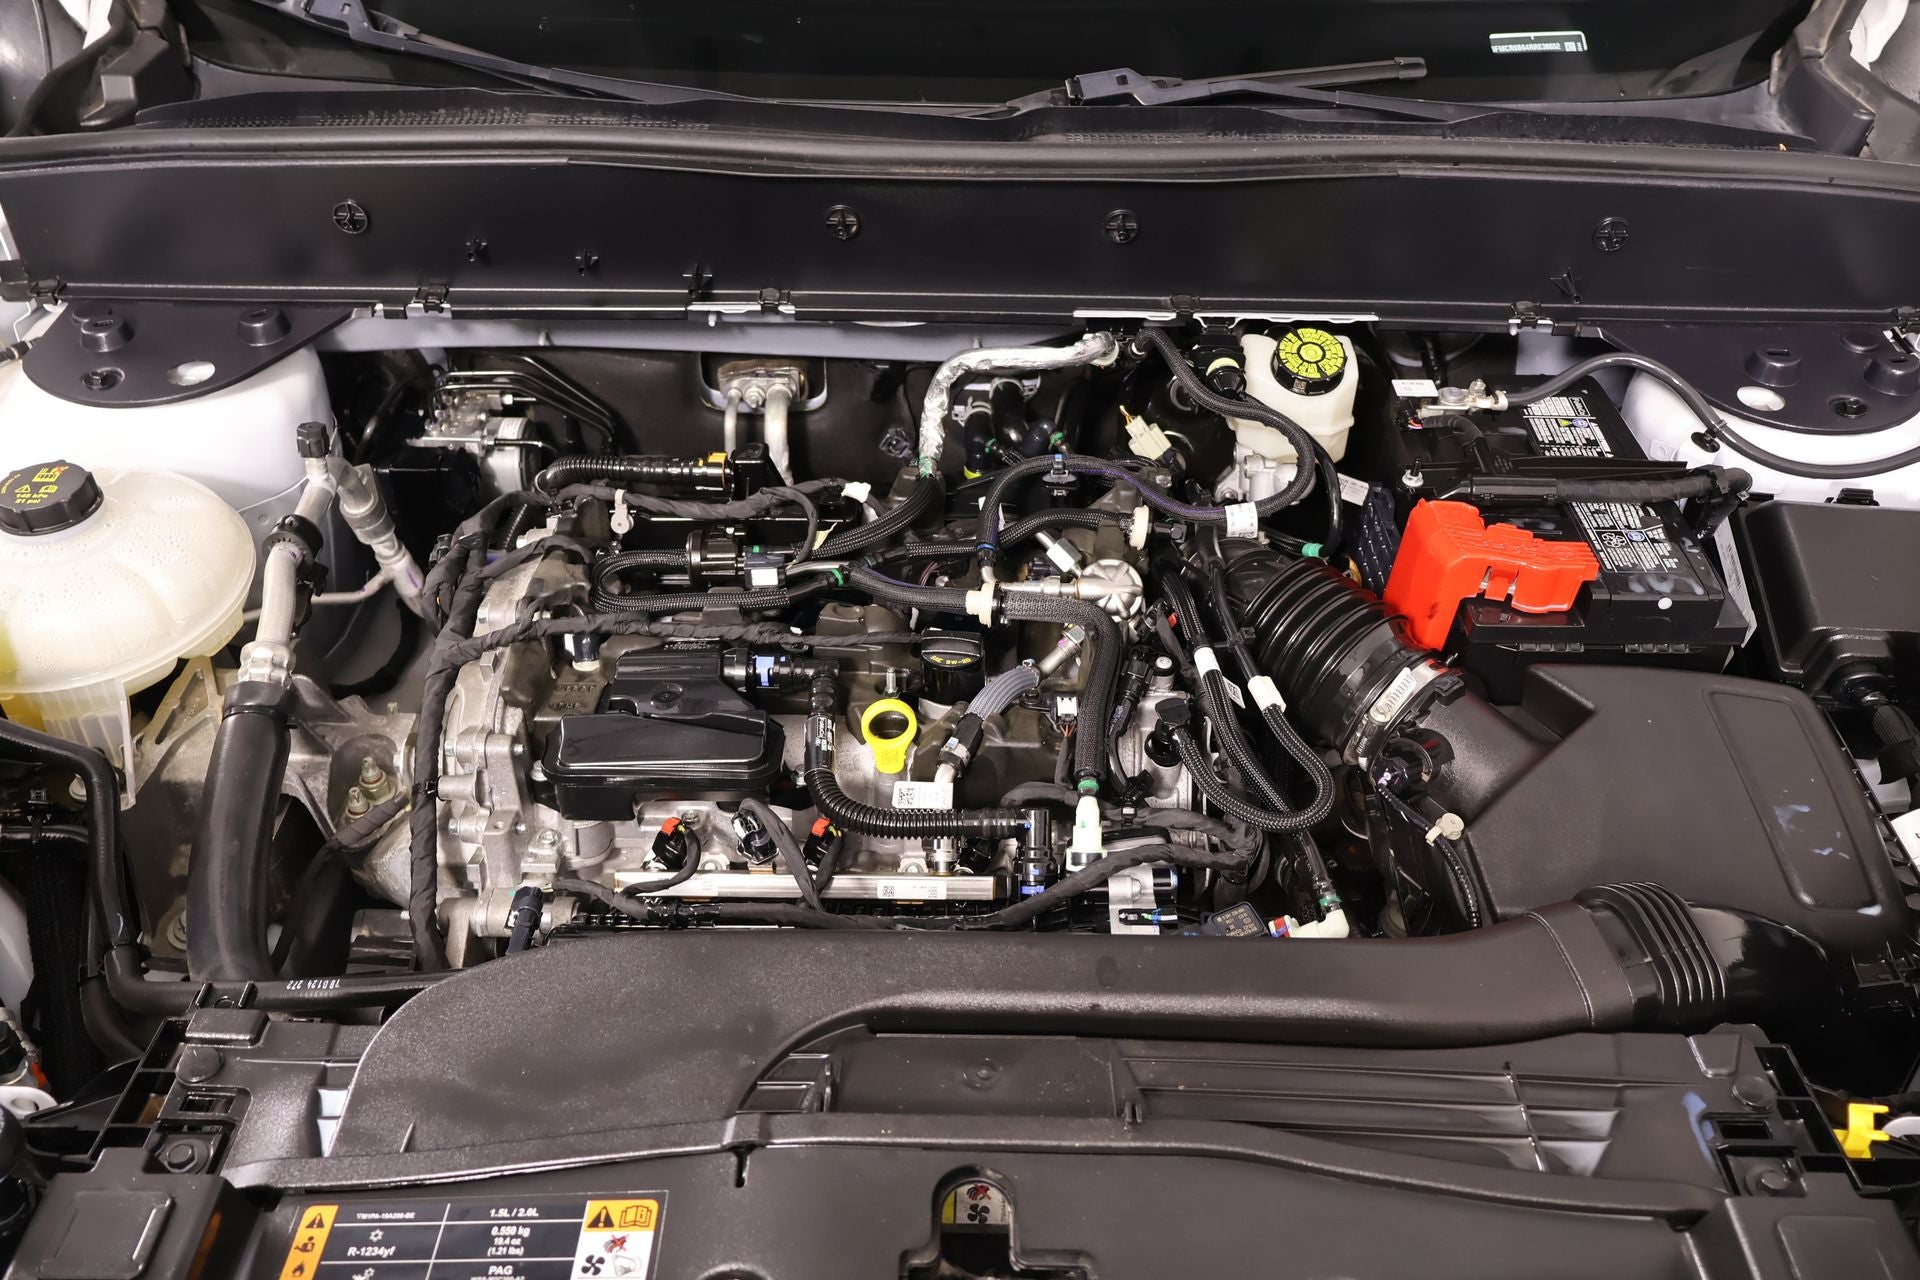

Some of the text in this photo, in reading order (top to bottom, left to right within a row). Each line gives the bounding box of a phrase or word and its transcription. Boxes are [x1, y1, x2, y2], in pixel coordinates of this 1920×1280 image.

[286, 980, 304, 990] 272
[489, 1208, 510, 1217] 1.5L
[517, 1207, 539, 1217] 2.0L
[491, 1225, 531, 1237] 0.550 kg
[347, 1246, 396, 1258] R-1234yf
[488, 1265, 513, 1275] PAG
